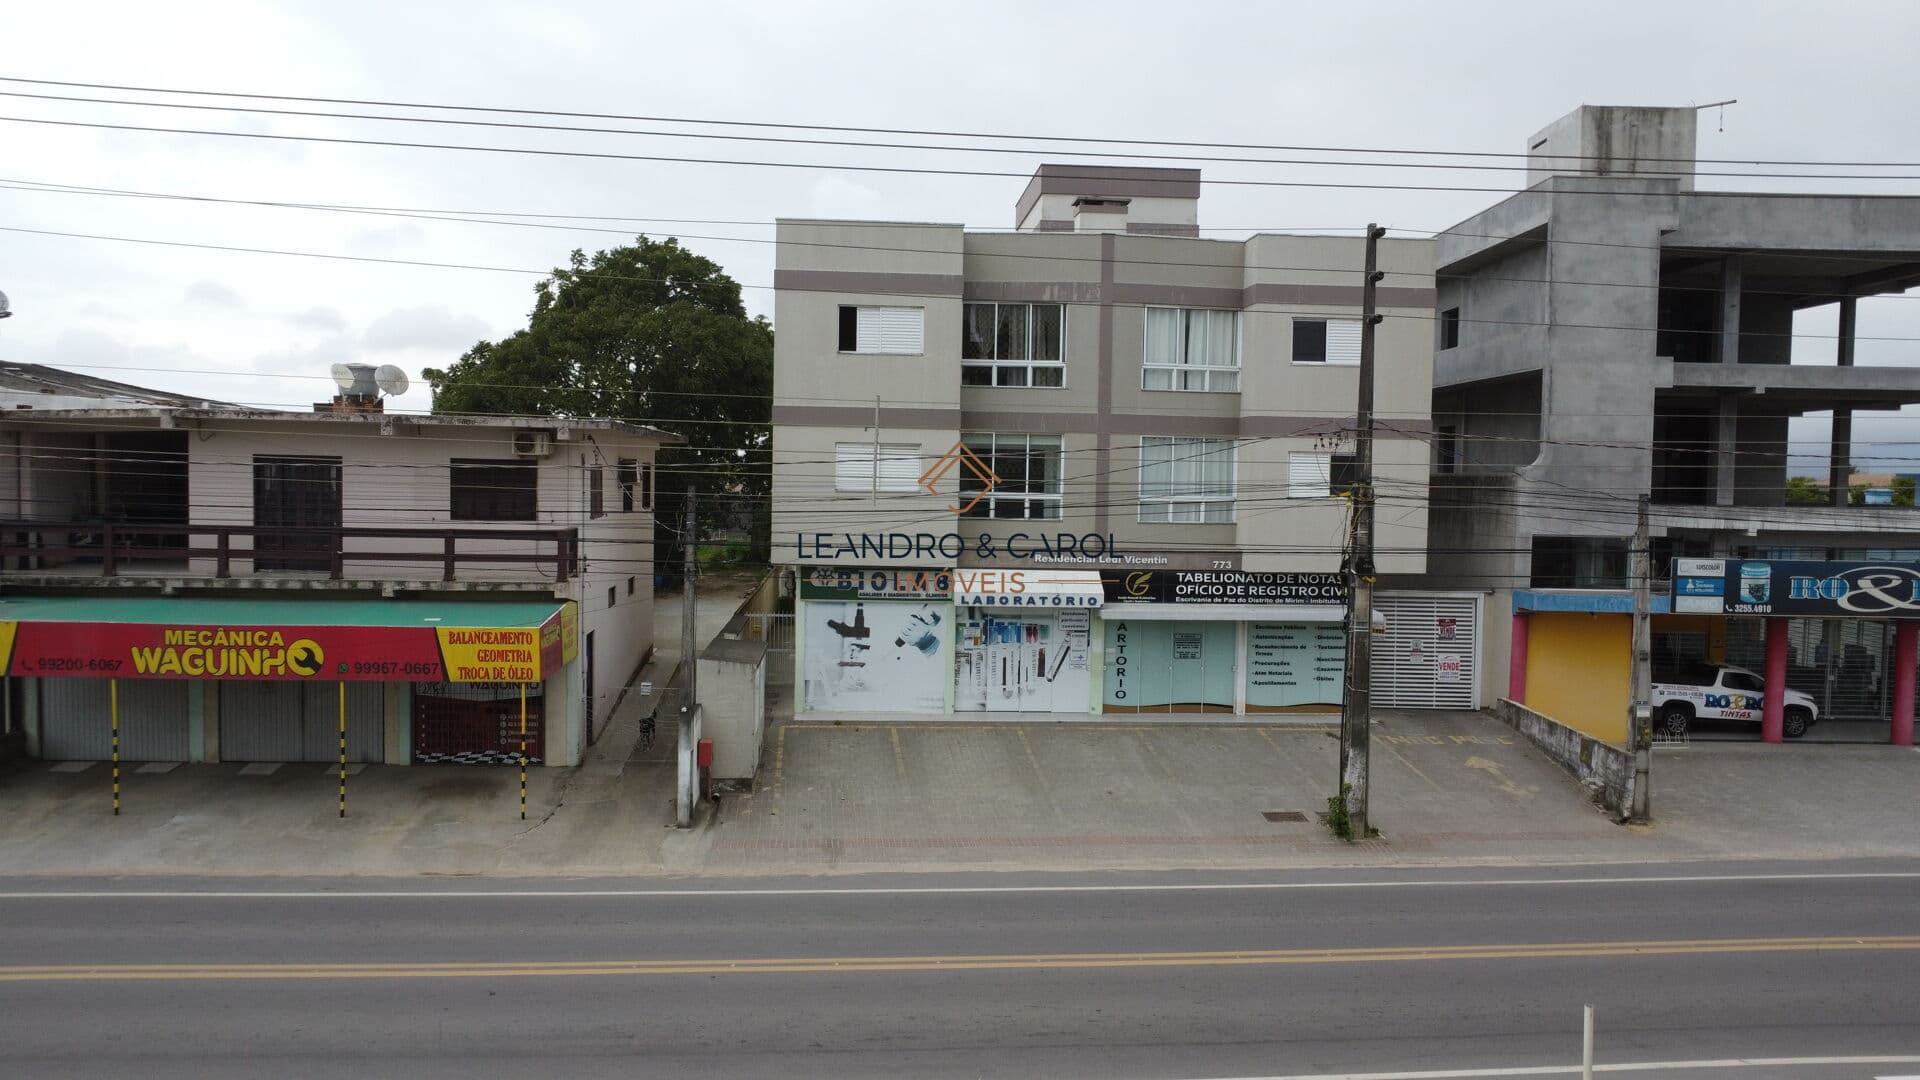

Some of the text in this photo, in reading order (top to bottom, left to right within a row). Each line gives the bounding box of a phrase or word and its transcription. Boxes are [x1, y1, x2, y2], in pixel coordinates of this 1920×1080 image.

[1124, 555, 1168, 564] Vicentin
[1213, 561, 1232, 569] 773
[1176, 572, 1274, 584] TABELIONATO
[1276, 574, 1295, 584] DE
[1175, 583, 1348, 597] OFÍCIO DE REGISTRO CIVI
[961, 594, 1098, 606] LABORATÓRIO
[1734, 604, 1772, 613] 3255.4910
[164, 627, 285, 646] MECÂNICA
[448, 631, 533, 645] BALANCEAMENTO
[131, 639, 325, 677] WAGUINHO
[477, 649, 533, 662] GEOMETRIA
[1115, 622, 1128, 699] ARTORIO
[38, 657, 123, 672] 99200-6067
[354, 662, 440, 675] 99967-0667
[1439, 662, 1460, 671] VENDE
[458, 665, 534, 681] TROCA DE ÓLEO
[1720, 710, 1753, 719] TINTAS
